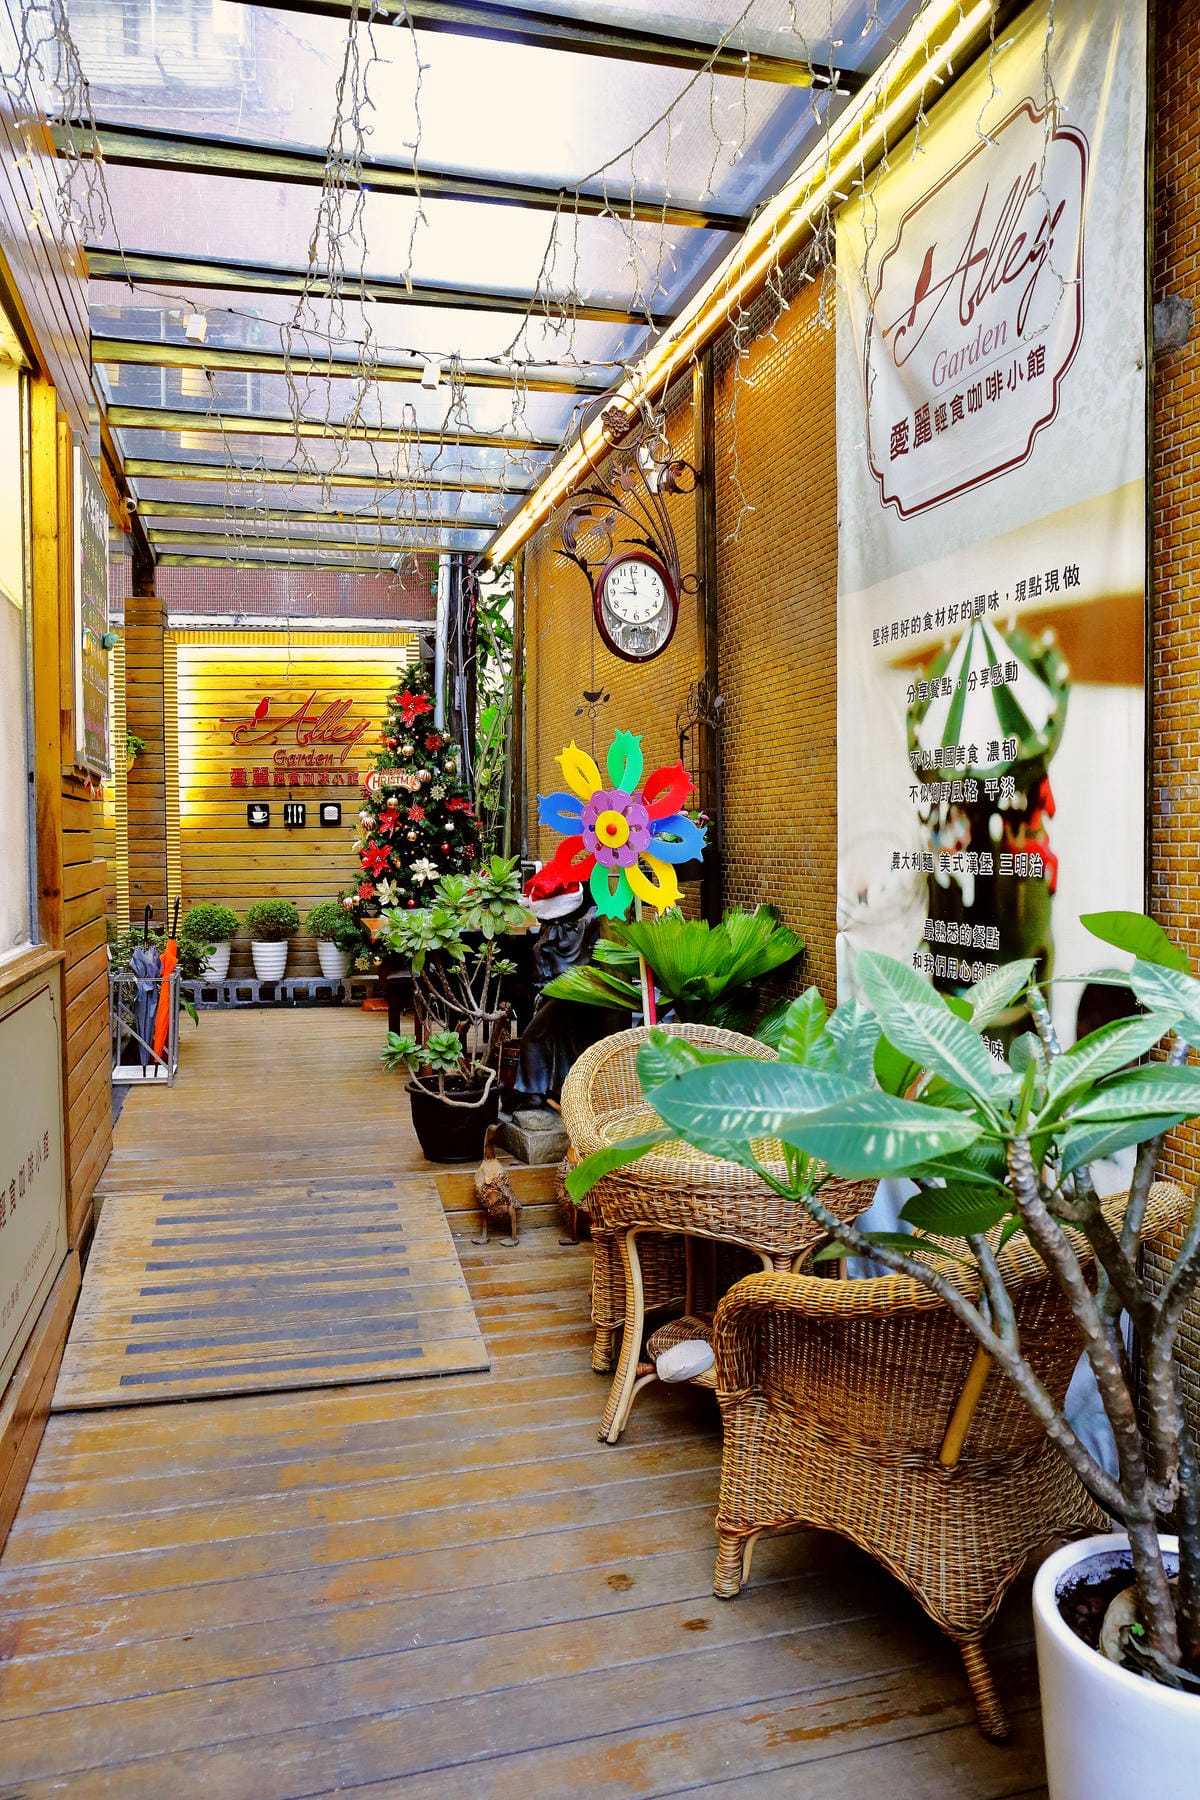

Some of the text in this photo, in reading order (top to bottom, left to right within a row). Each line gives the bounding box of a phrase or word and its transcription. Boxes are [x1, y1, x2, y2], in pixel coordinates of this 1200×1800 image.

[882, 162, 1066, 368] Alley
[932, 319, 1008, 388] Garden
[889, 343, 1047, 462] 愛麗輕食咖啡小館
[906, 660, 1019, 704] 分享餐點，分享感動
[219, 689, 372, 765] Alley
[273, 748, 334, 766] Garden
[986, 738, 1017, 763] 濃郁
[984, 776, 1016, 800] 平淡
[939, 851, 994, 876] 美式漢堡
[998, 852, 1044, 878] 三明治
[923, 918, 1000, 951] 最熟悉的餐點
